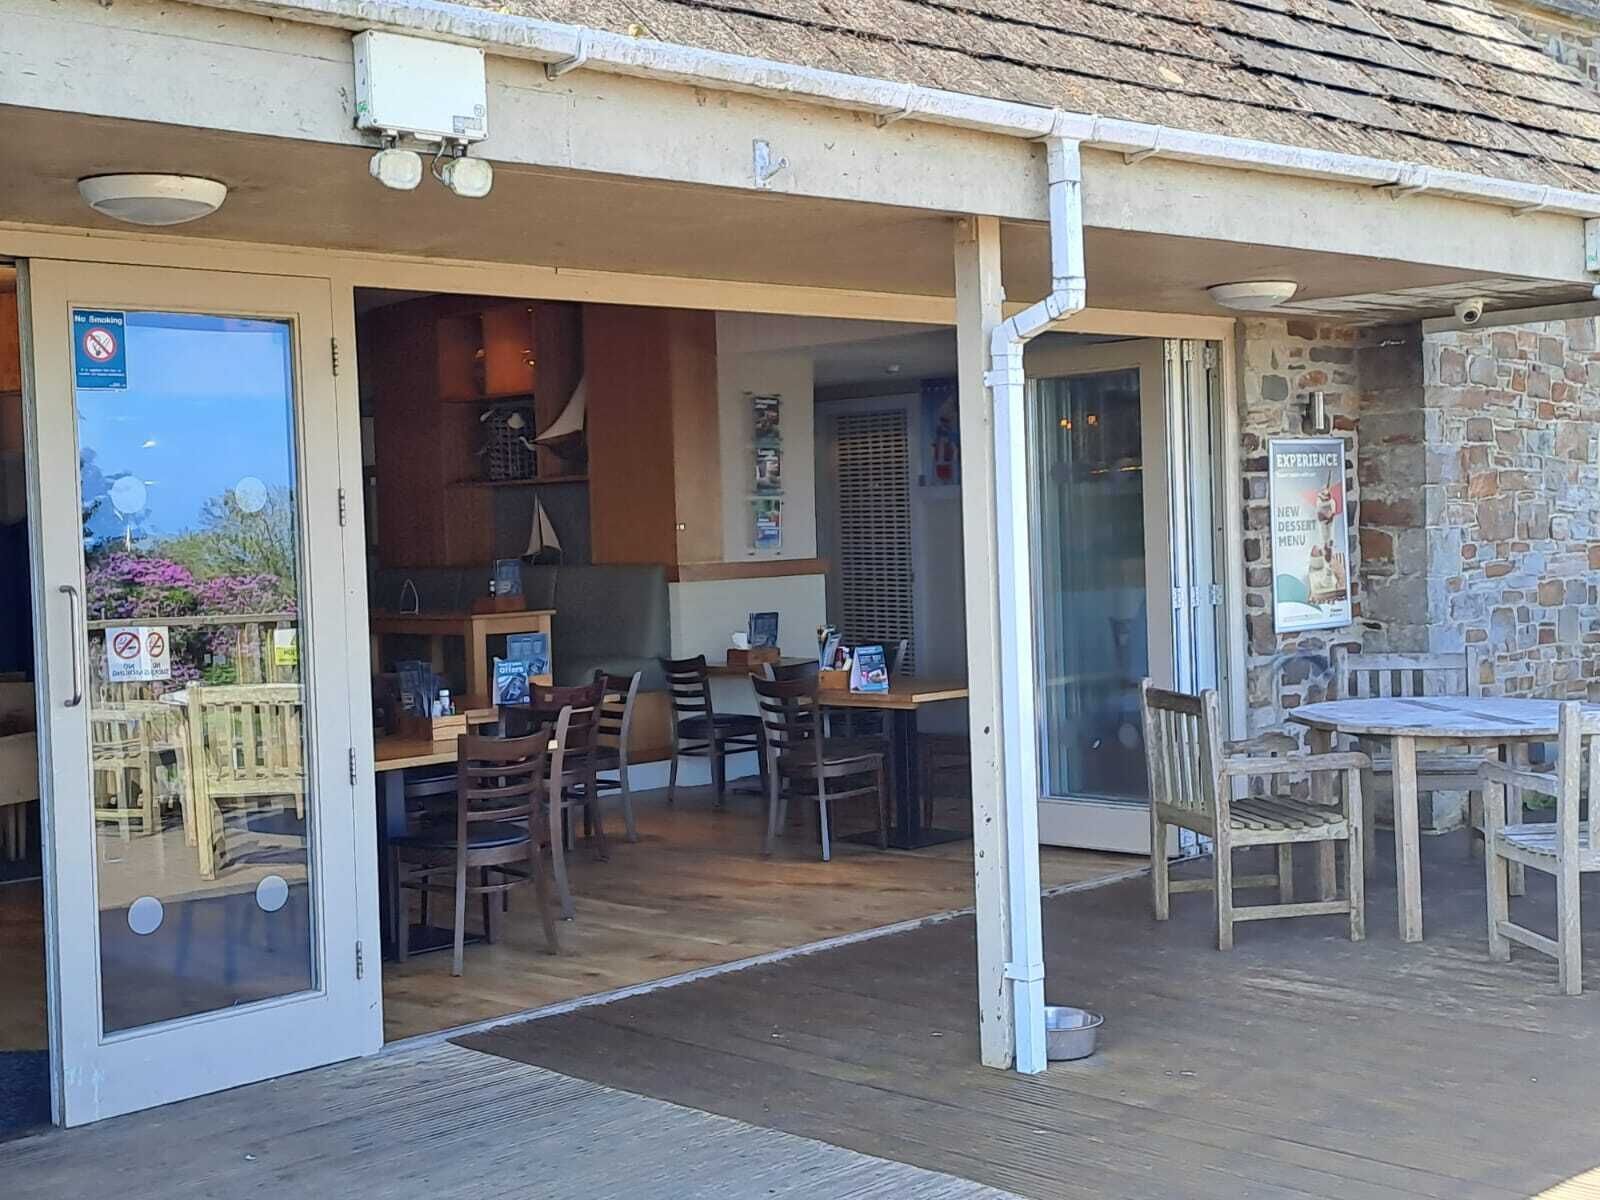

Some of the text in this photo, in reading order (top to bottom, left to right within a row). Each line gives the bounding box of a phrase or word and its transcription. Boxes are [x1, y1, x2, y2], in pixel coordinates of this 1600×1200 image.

[88, 315, 123, 326] Smoking
[1276, 453, 1339, 467] EXPERIENCE
[1277, 505, 1300, 518] NEW
[1277, 519, 1316, 532] DESSERT
[1278, 534, 1306, 547] MENU
